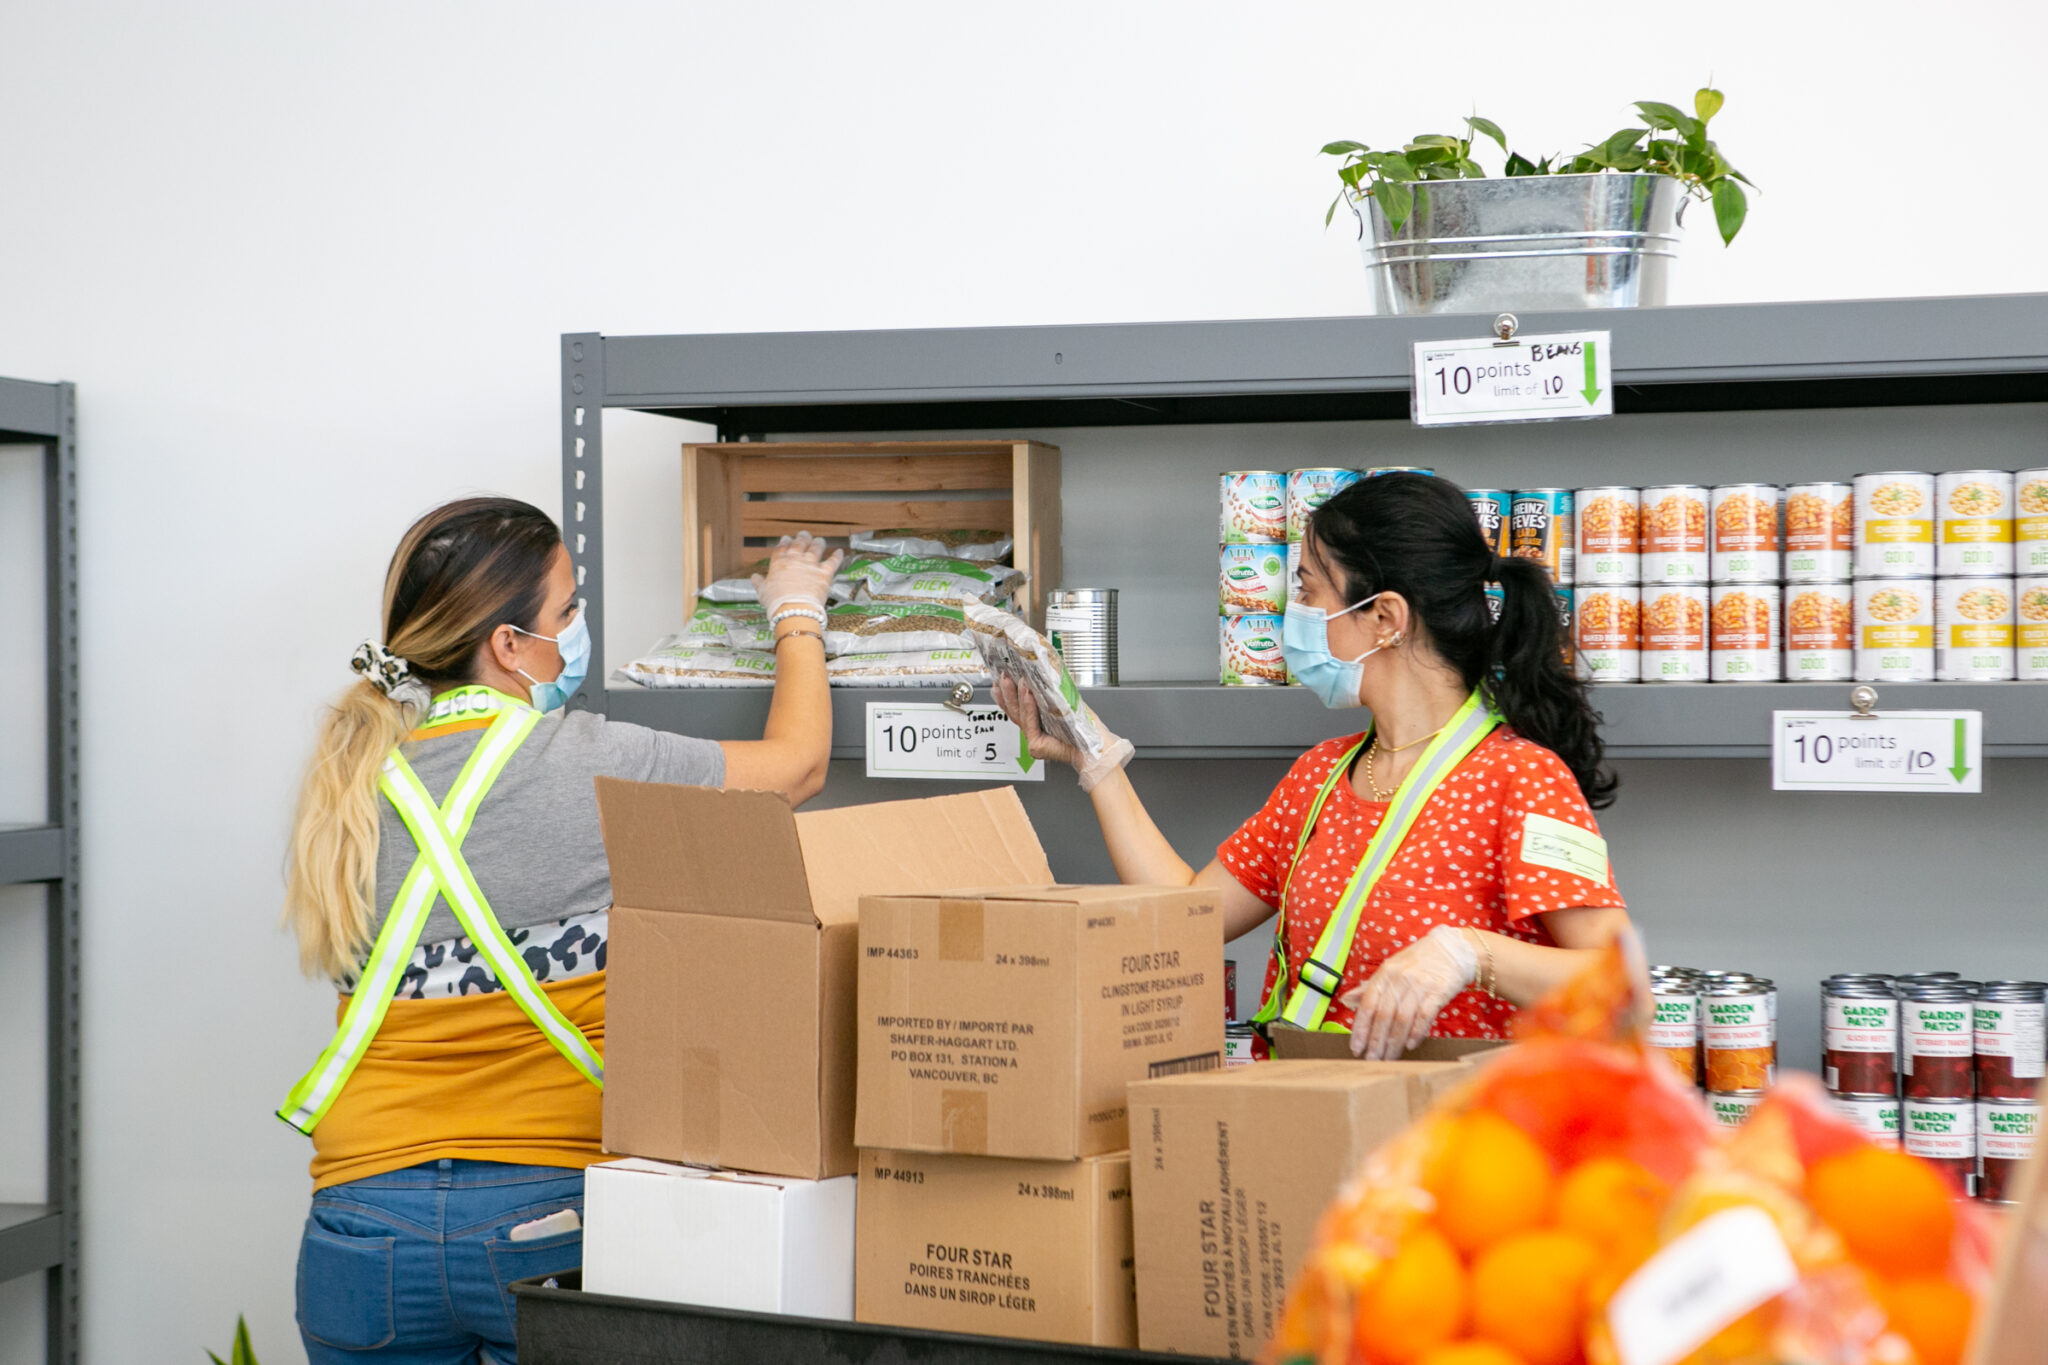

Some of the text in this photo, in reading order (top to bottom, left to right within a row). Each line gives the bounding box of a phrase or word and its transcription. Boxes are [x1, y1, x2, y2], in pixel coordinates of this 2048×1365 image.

[1531, 341, 1582, 362] BEANS
[1435, 363, 1531, 396] 10 points
[1493, 375, 1564, 397] limit of 10
[1471, 502, 1499, 515] EINZ
[1513, 502, 1545, 515] HEINZ
[912, 579, 953, 592] BIEN
[883, 724, 972, 753] 10 points
[936, 743, 998, 761] limit of 5
[1794, 733, 1897, 764] 10 points
[1855, 757, 1885, 769] limit
[995, 954, 1008, 965] 24
[1121, 950, 1181, 975] FOUR STAR
[1101, 972, 1205, 999] CLINGSTONE PEACH HALVES
[1121, 995, 1184, 1017] IN LIGHT SYRUP
[1656, 1003, 1692, 1013] ARDEN
[1708, 1004, 1755, 1014] GARDEN
[1843, 1005, 1890, 1017] GARDEN
[1713, 1015, 1751, 1025] PATCH
[1847, 1017, 1885, 1028] PATCH
[1918, 1009, 1967, 1021] GARDEN
[877, 1016, 934, 1030] IMPORTED
[936, 1018, 952, 1030] BY
[959, 1019, 1009, 1034] IMPORTÉ
[1011, 1023, 1034, 1036] PAR
[1923, 1021, 1962, 1032] PATCH
[890, 1033, 1020, 1052] SHAFER-HAGGART LTD.
[891, 1051, 907, 1063] PO
[909, 1052, 933, 1064] BOX
[961, 1055, 1008, 1069] STATION
[1009, 1058, 1018, 1069] A
[909, 1068, 999, 1085] VANCOUVER, BC
[1910, 1110, 1957, 1122] GARDEN
[1988, 1111, 2038, 1124] GARDEN
[1914, 1121, 1952, 1133] PATCH
[1993, 1123, 2034, 1135] PATCH
[1217, 1120, 1232, 1196] ADHÉRENT
[893, 1169, 925, 1184] 44913
[1017, 1182, 1075, 1202] 24 x 398ml
[926, 1243, 1013, 1270] FOUR STAR
[1200, 1200, 1223, 1318] FOUR STAR
[909, 1262, 1031, 1291] POIRES TRANCHÉES
[904, 1282, 1037, 1312] DANS UN SIROP LÉGER
